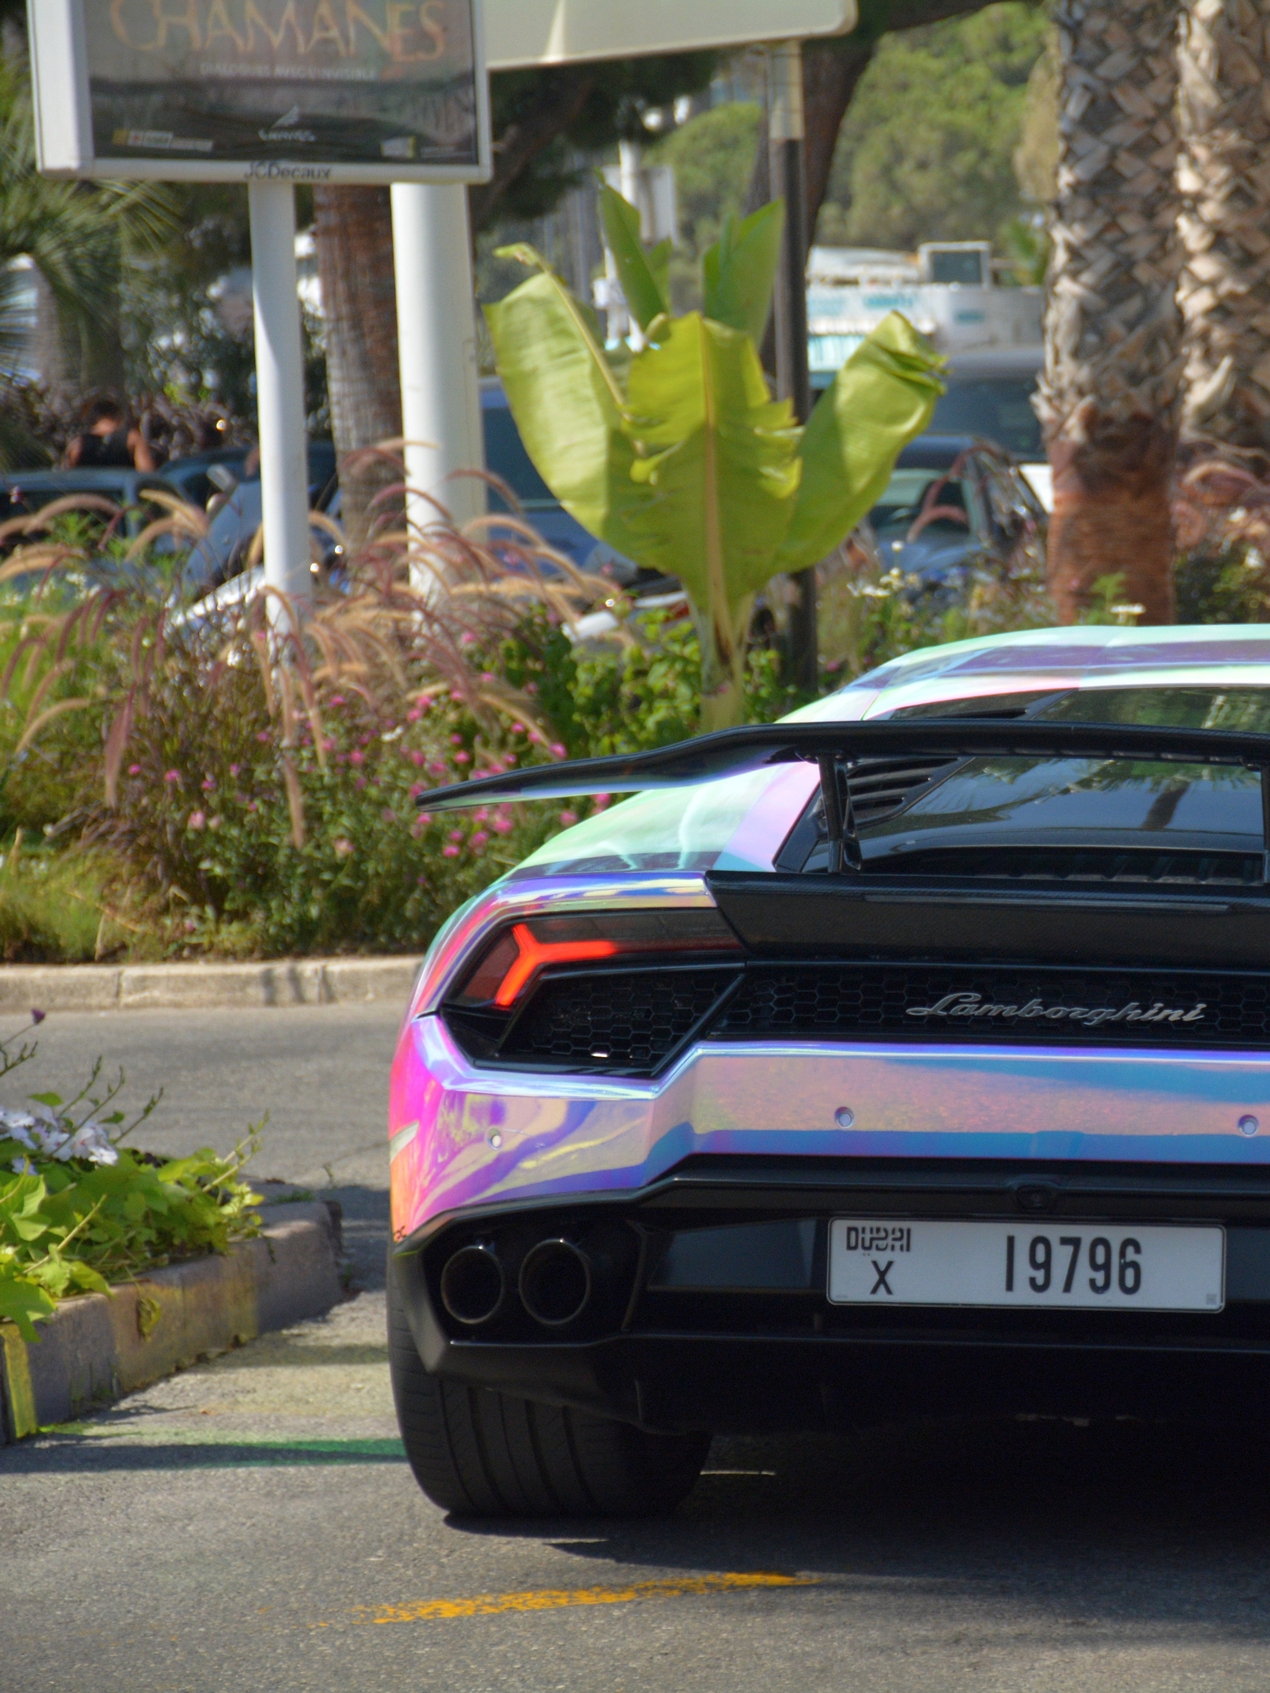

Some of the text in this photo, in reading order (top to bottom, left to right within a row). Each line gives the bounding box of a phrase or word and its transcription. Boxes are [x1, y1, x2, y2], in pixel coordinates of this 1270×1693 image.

[108, 0, 446, 62] CHAMANES
[243, 160, 331, 180] JCDecaux
[905, 992, 1208, 1026] Lamborghini
[869, 1260, 895, 1296] X
[1004, 1234, 1142, 1296] 19796
